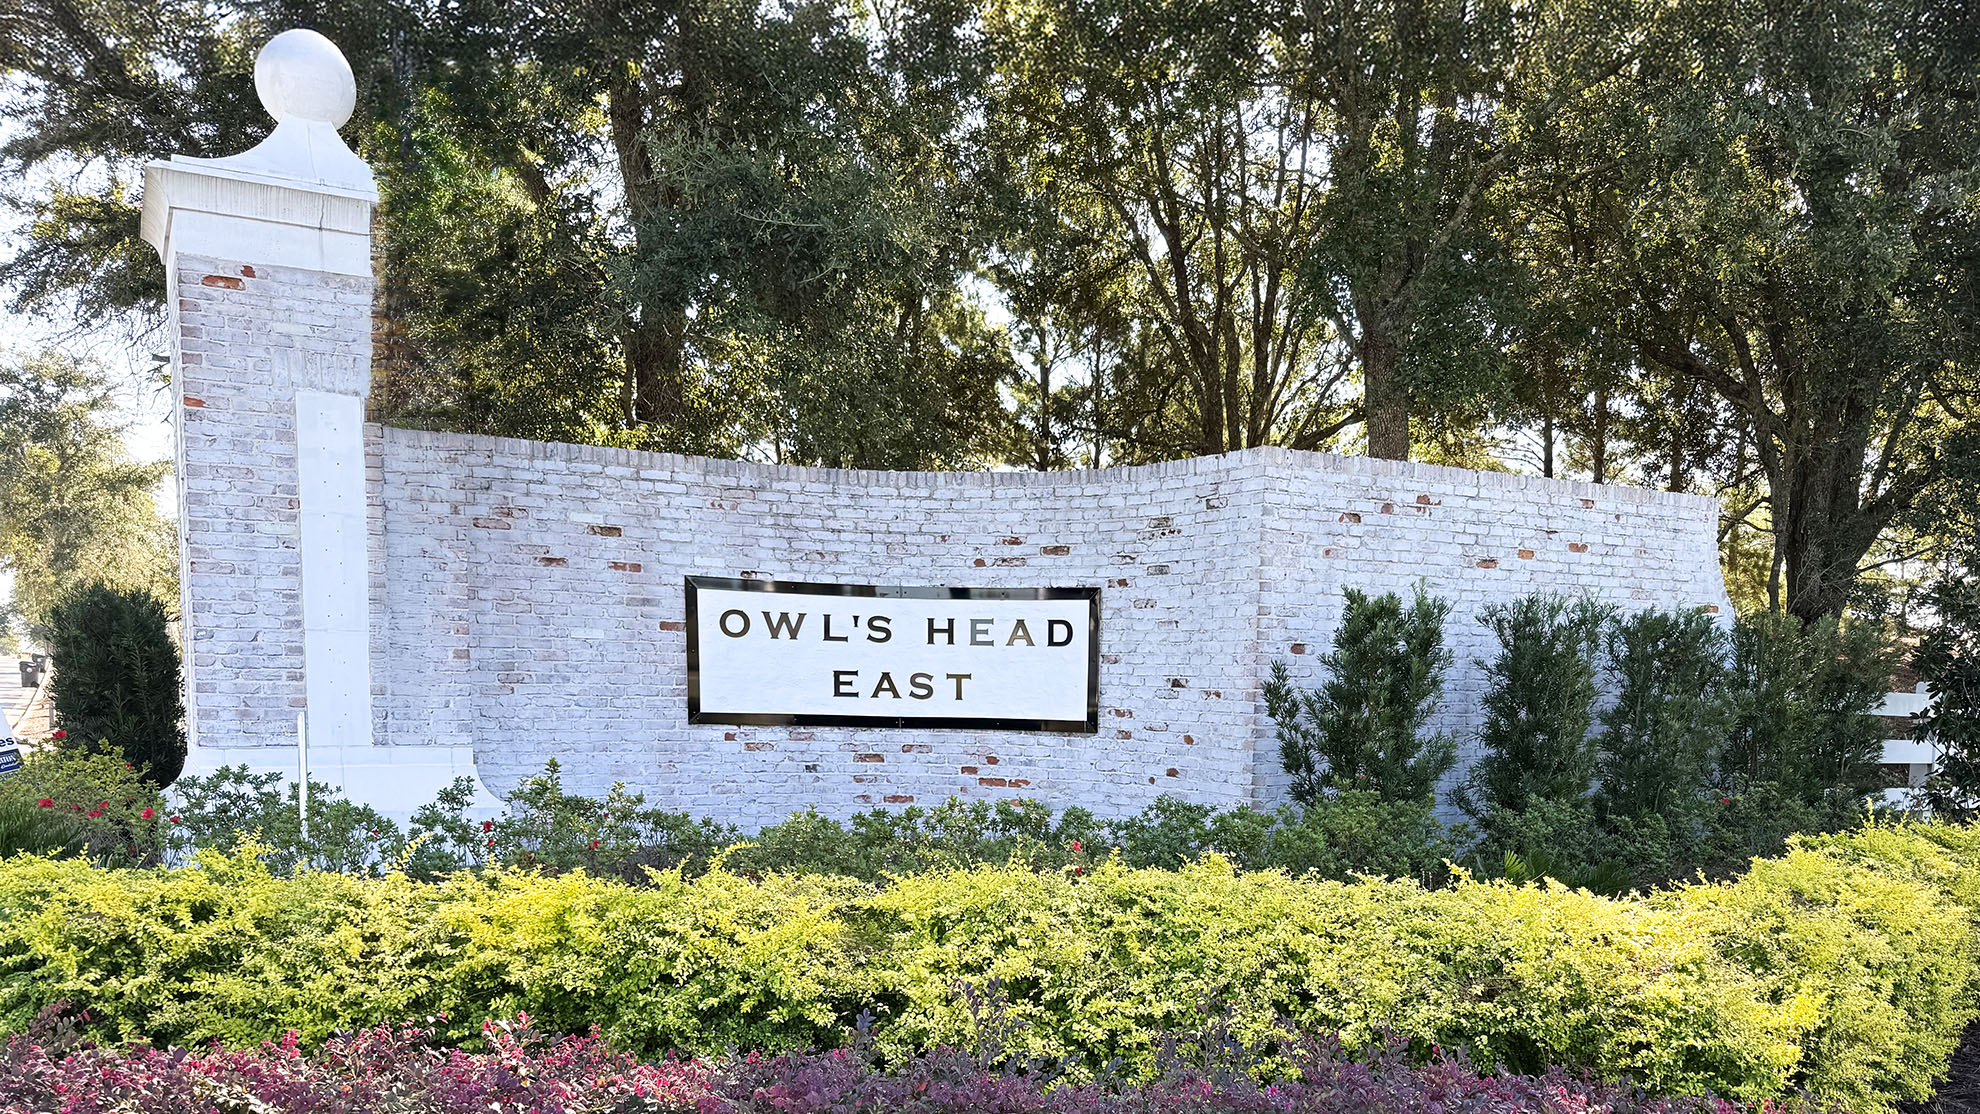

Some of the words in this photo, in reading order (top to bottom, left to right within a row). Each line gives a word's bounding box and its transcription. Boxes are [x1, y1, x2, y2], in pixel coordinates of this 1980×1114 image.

[719, 609, 892, 643] OWL'S
[927, 618, 1074, 646] HEAD
[833, 670, 972, 701] EAST
